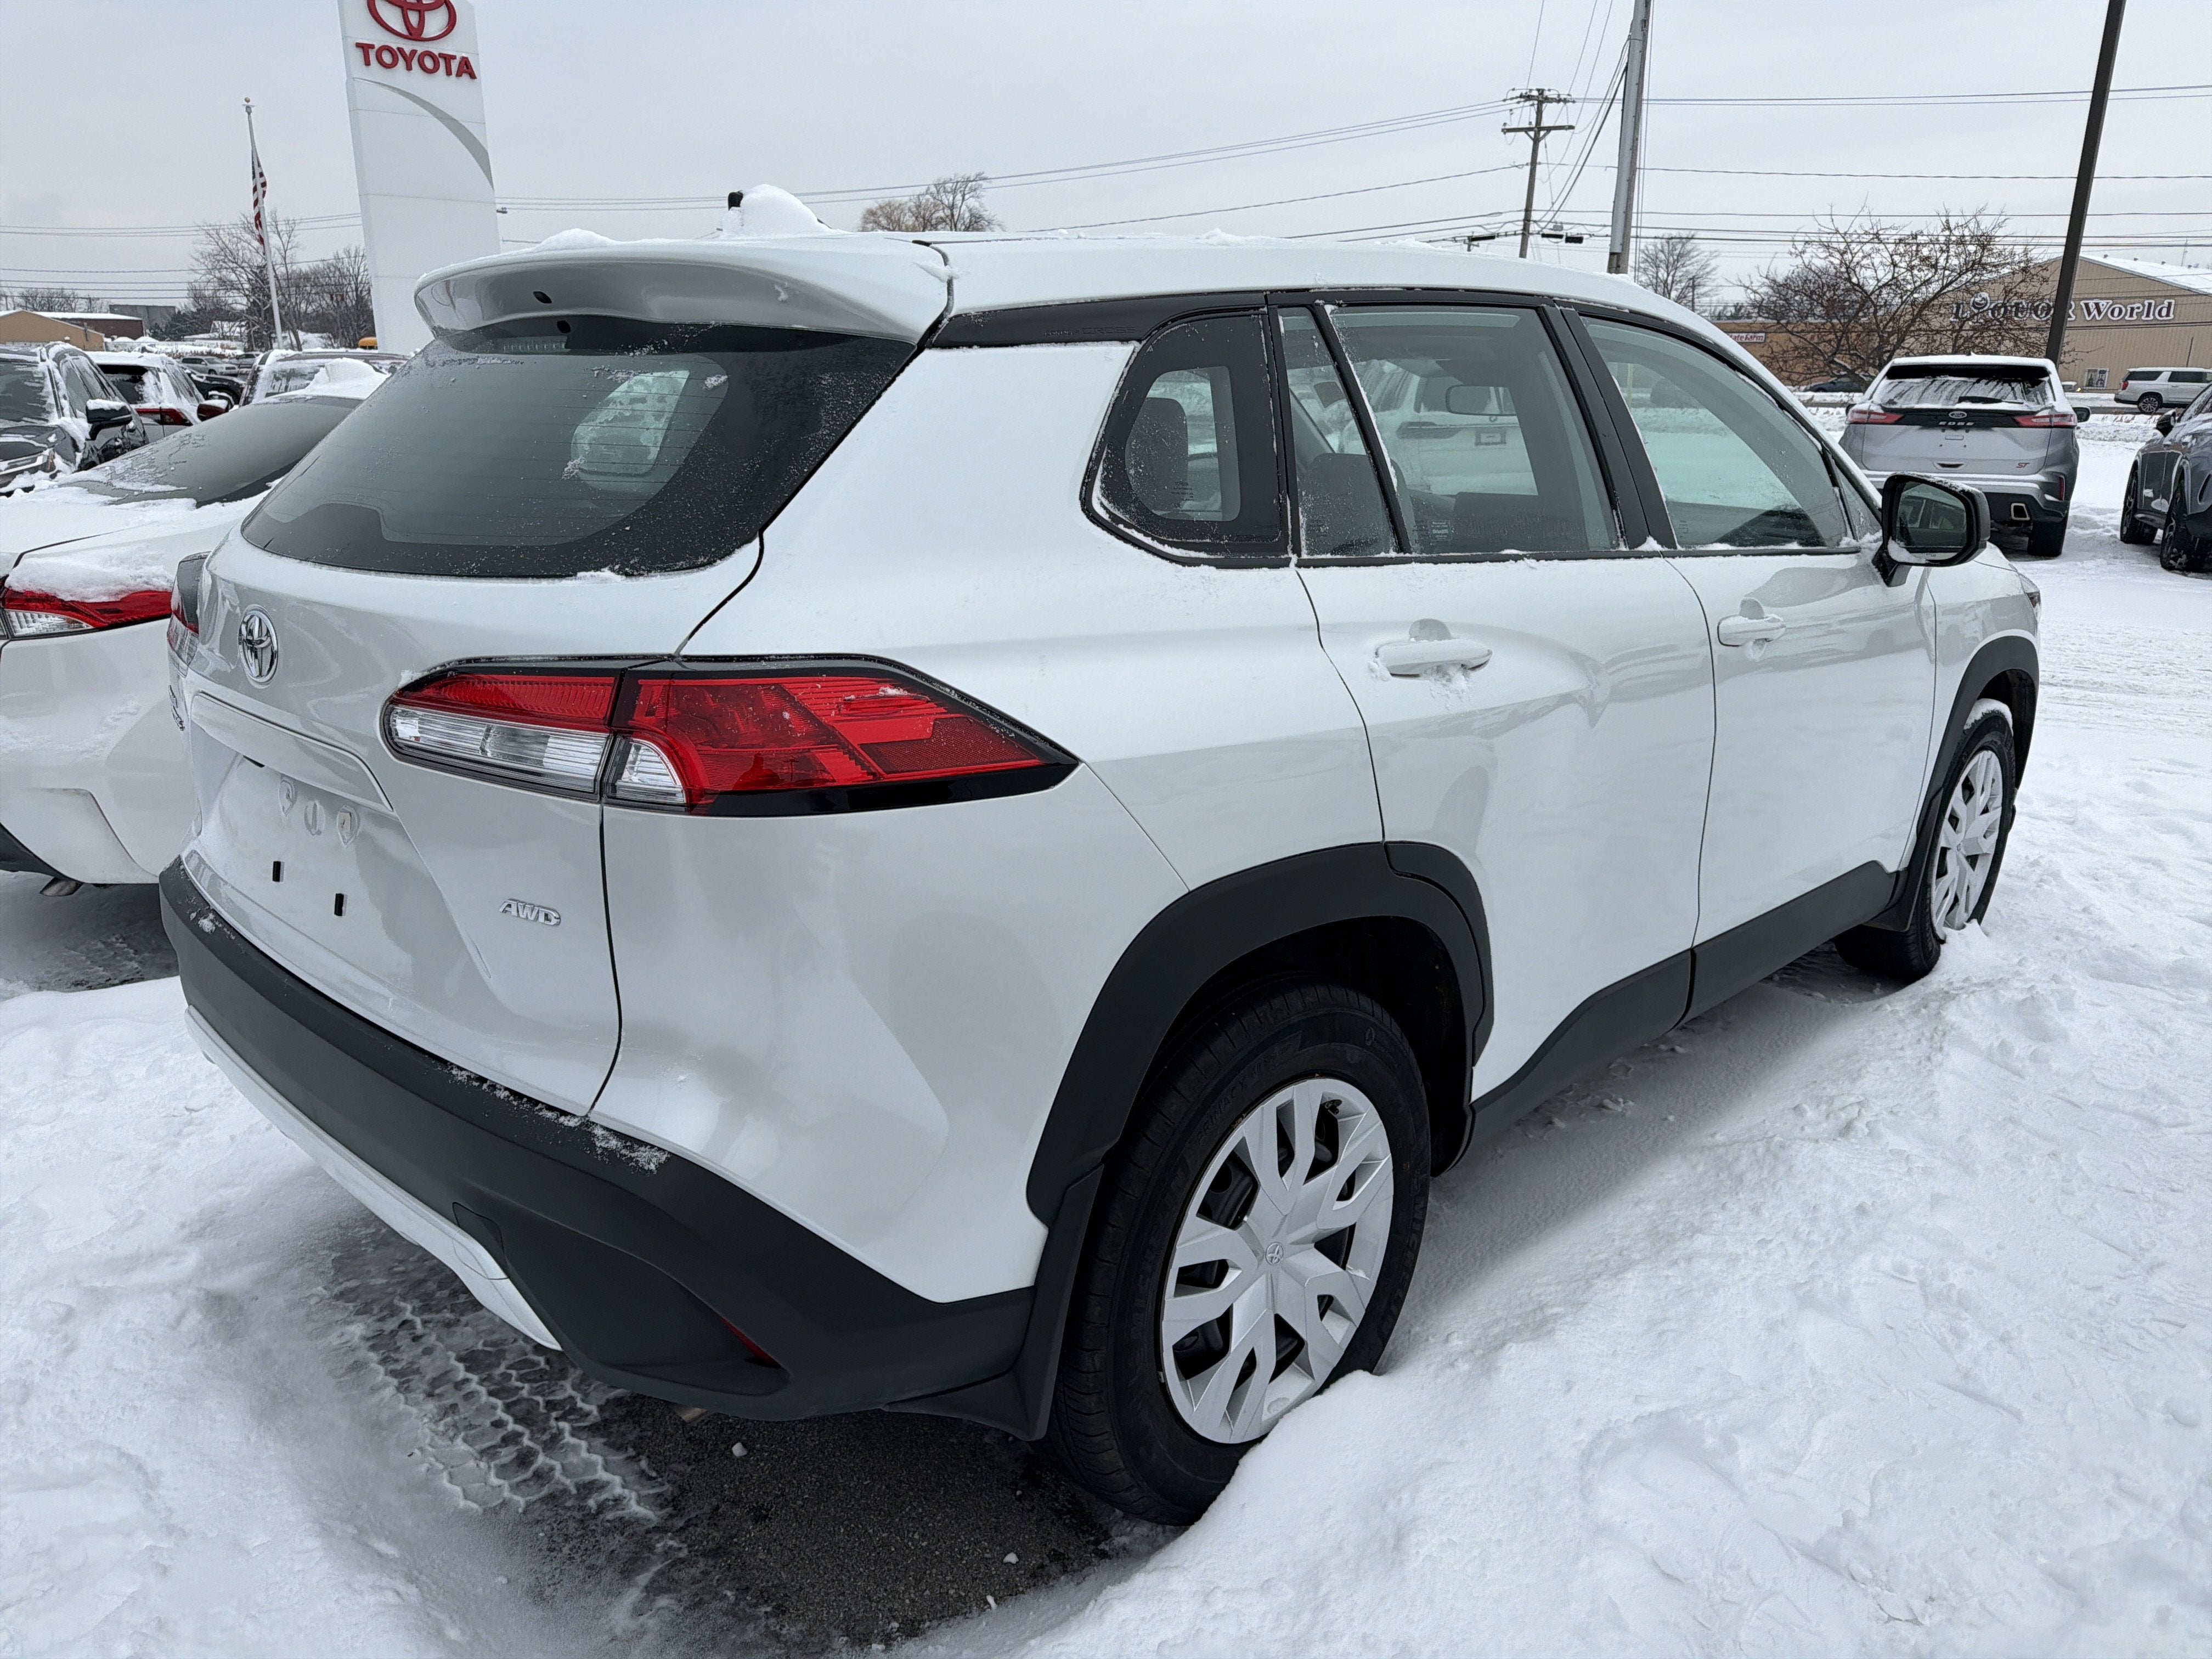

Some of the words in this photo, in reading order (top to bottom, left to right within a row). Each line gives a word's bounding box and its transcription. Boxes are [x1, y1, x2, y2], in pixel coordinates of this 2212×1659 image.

[355, 42, 477, 80] TOYOTA
[2080, 299, 2175, 320] World
[499, 898, 561, 926] AWD
